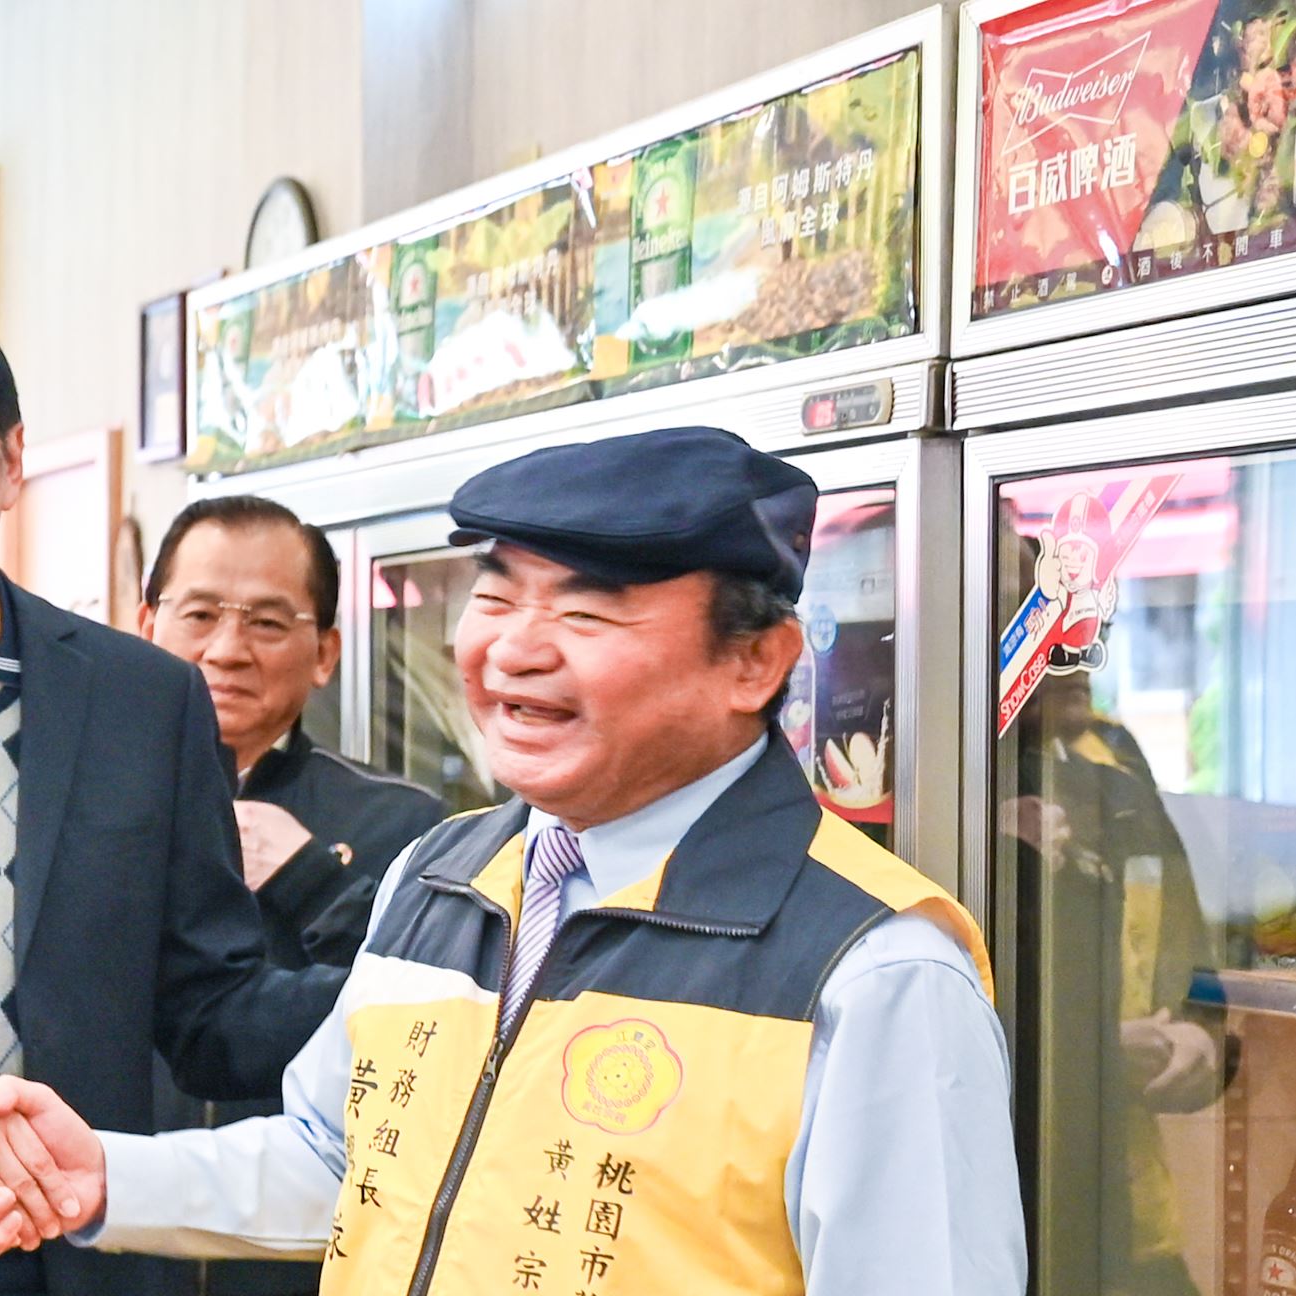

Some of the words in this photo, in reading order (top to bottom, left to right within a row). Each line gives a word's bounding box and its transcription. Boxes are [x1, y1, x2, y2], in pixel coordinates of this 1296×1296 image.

[1013, 69, 1136, 126] Budweiser
[1007, 132, 1137, 215] 百威啤酒
[1136, 229, 1284, 277] 酒後不開車
[355, 1020, 438, 1209] 財務組長
